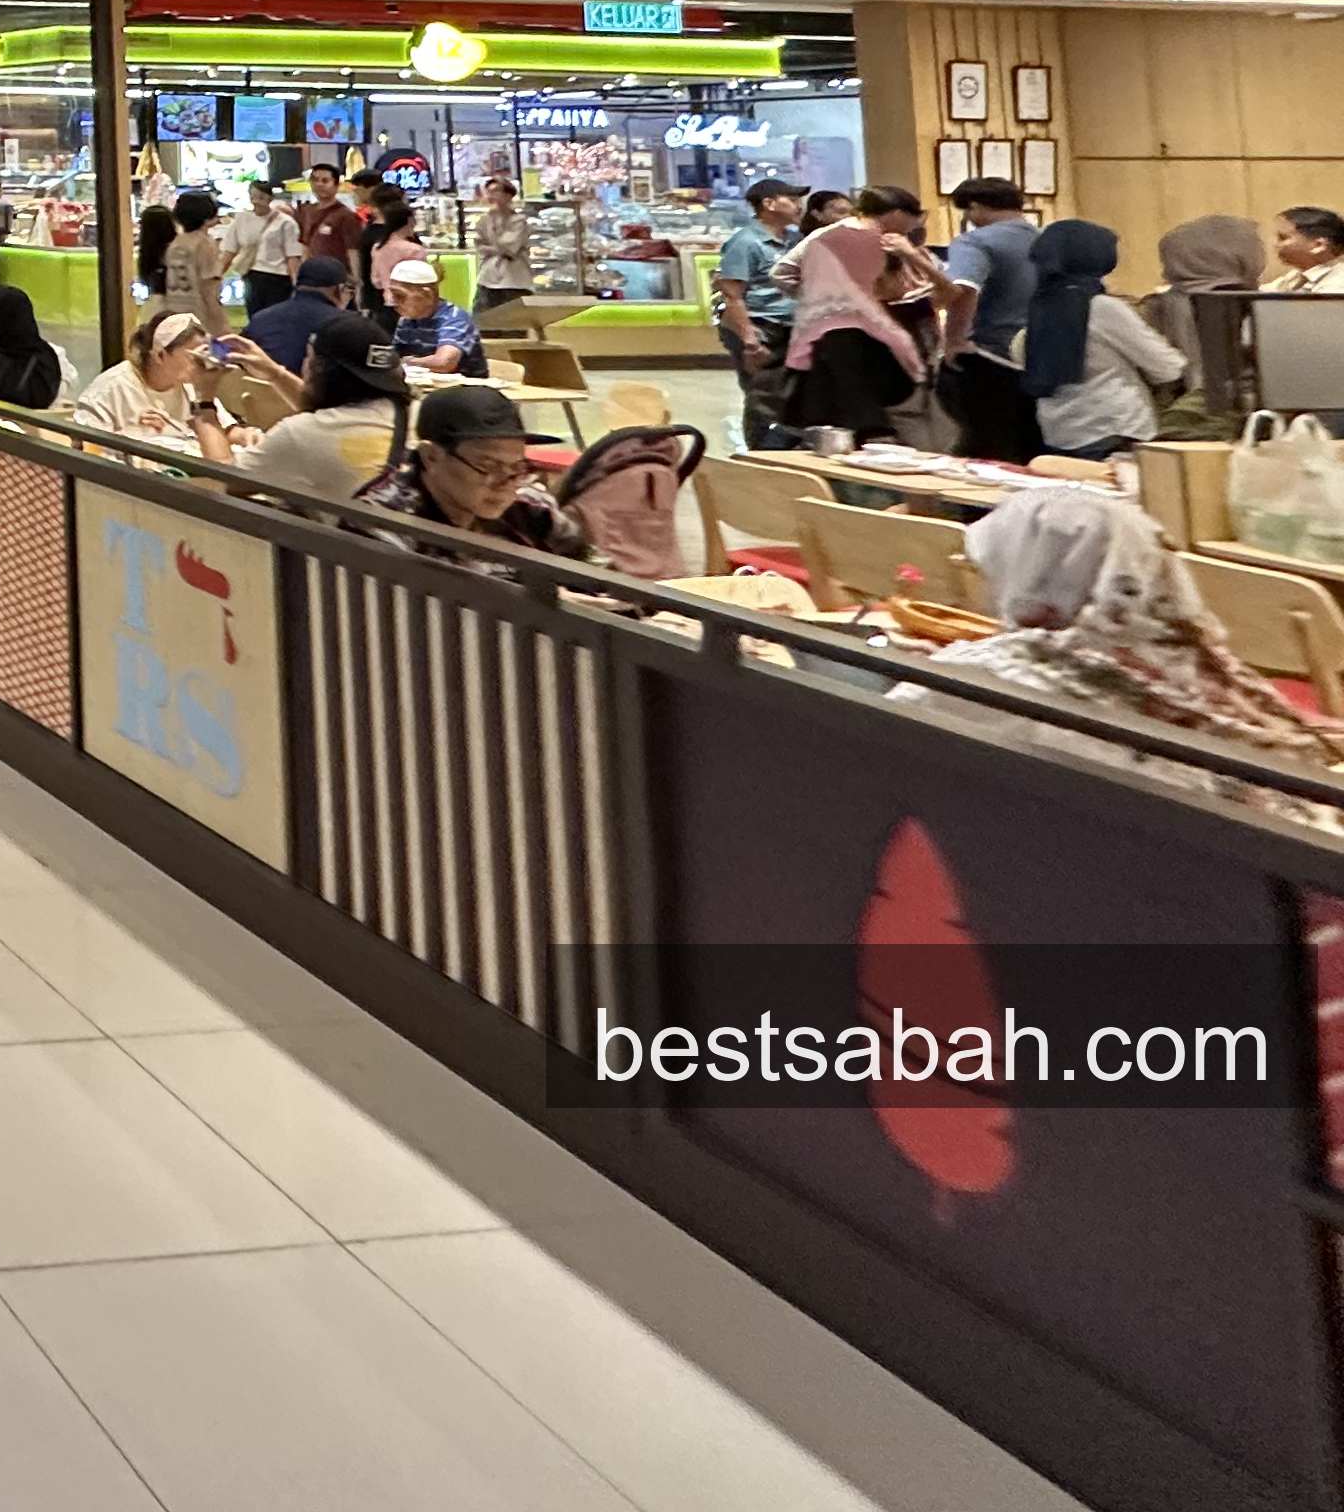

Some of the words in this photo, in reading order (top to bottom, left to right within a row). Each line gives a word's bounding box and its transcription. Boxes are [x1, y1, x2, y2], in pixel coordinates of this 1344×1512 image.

[588, 4, 657, 29] KELUAR
[103, 517, 165, 635] T
[111, 631, 243, 798] RS
